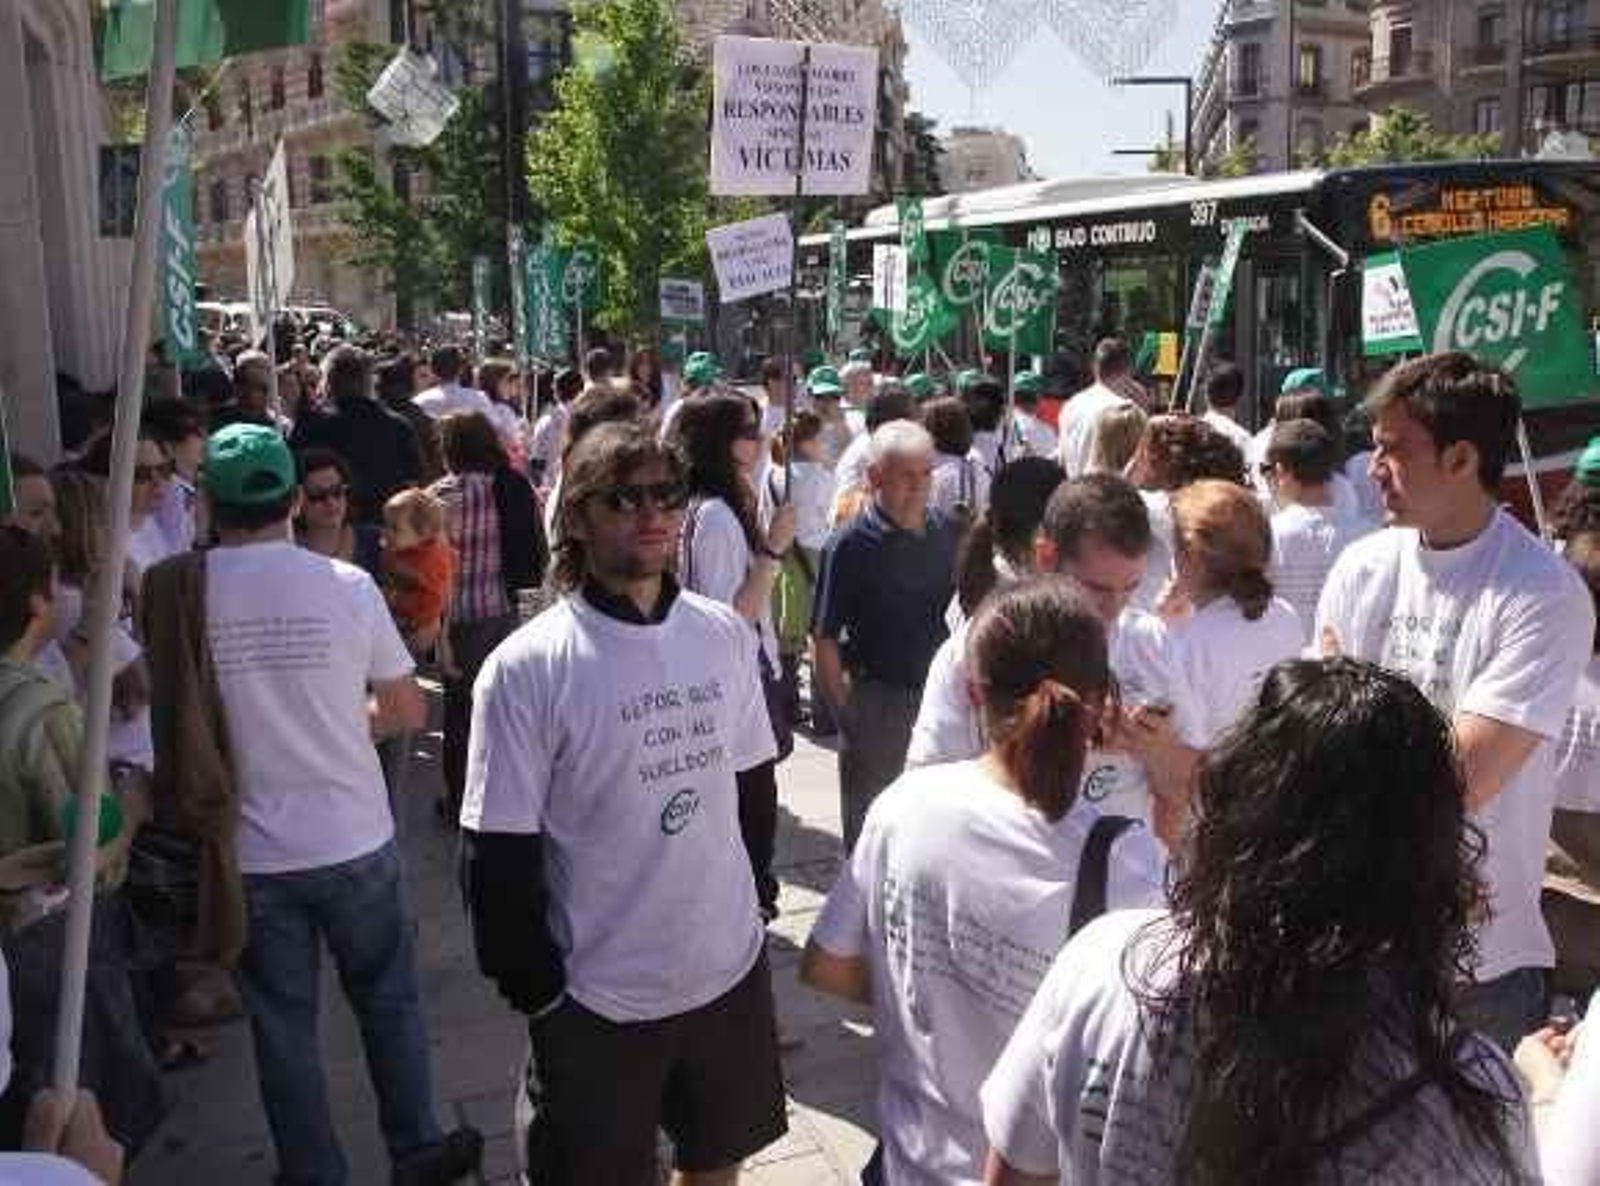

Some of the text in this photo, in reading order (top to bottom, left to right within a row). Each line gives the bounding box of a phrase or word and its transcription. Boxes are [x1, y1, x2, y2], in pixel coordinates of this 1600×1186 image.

[723, 99, 864, 124] RESPONABLES
[739, 146, 852, 172] VICTMAS
[1190, 201, 1217, 226] 397
[1055, 227, 1087, 248] BAJO
[1091, 220, 1156, 246] CONTINUO
[165, 203, 193, 350] CSI-F
[1454, 281, 1564, 349] CSI-F
